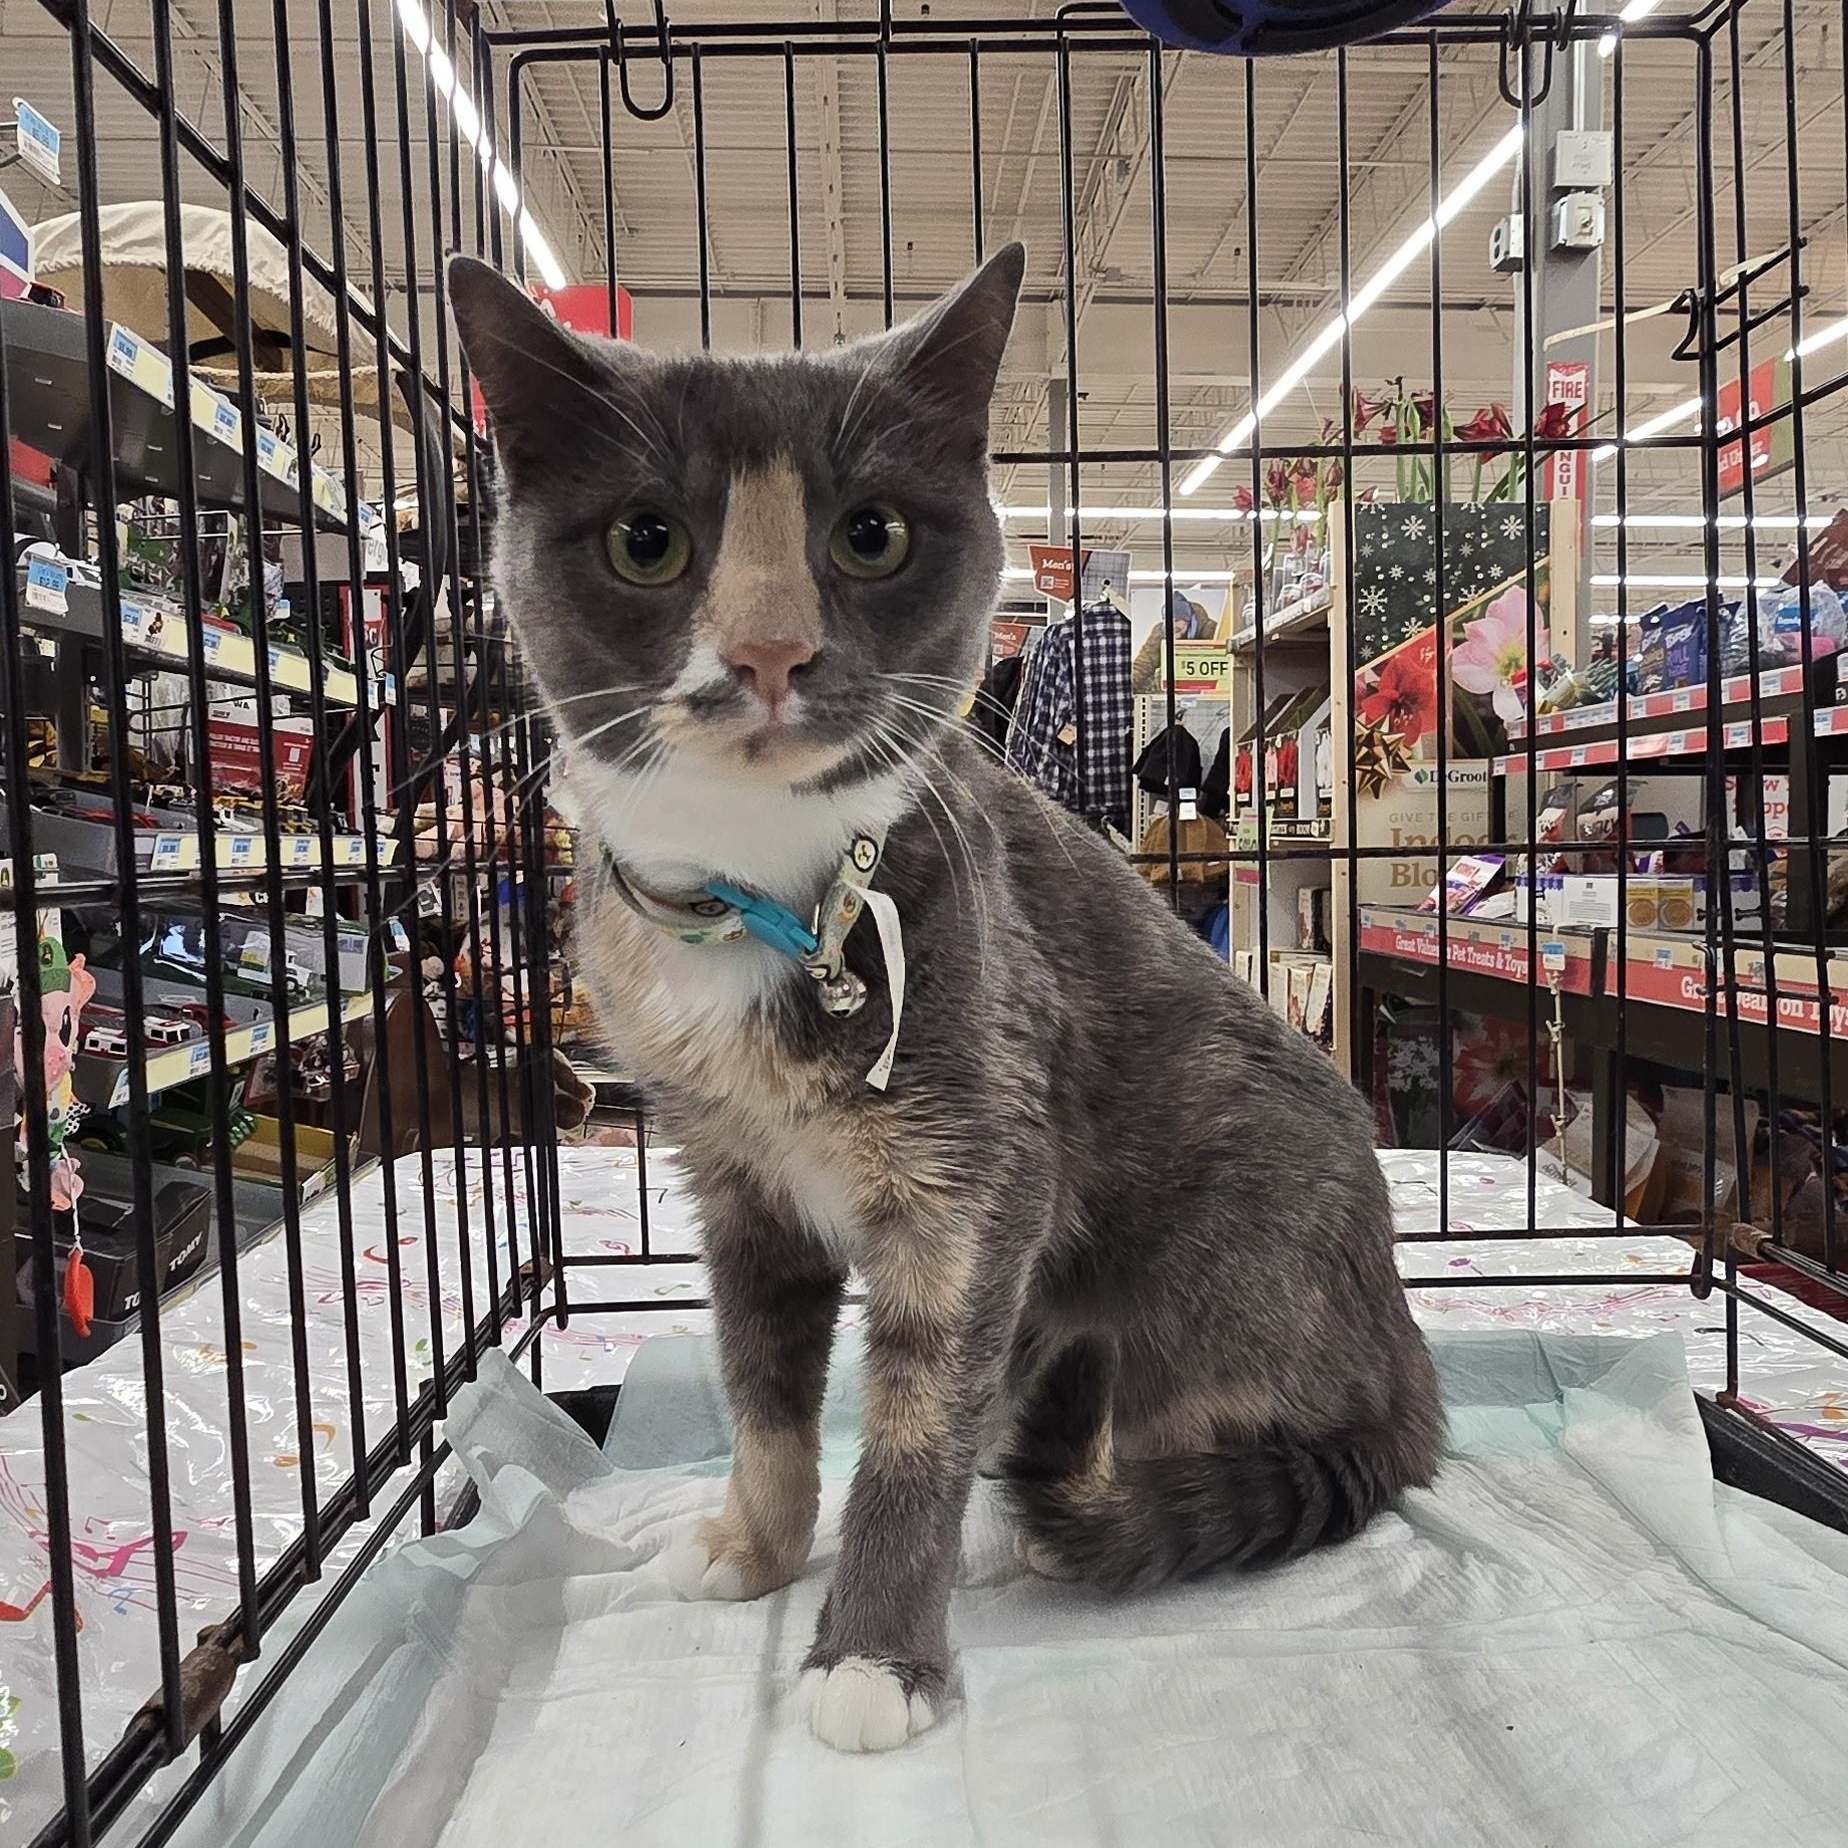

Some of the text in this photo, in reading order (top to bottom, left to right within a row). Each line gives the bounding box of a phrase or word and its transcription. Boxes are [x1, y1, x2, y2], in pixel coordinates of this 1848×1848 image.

[1552, 380, 1583, 399] FIRE
[1042, 558, 1073, 571] Men's
[1181, 660, 1229, 676] $5 OFF
[1429, 769, 1487, 784] DGroot
[1389, 812, 1423, 823] GIVE
[1428, 811, 1456, 823] TE
[1460, 811, 1487, 823] GIF
[1395, 935, 1416, 951] Great
[1452, 944, 1467, 962] Pet
[1467, 946, 1495, 968] Treats
[1495, 952, 1504, 969] &
[1504, 953, 1529, 979] Toys
[168, 1231, 203, 1272] TOMY
[124, 1291, 141, 1311] TO
